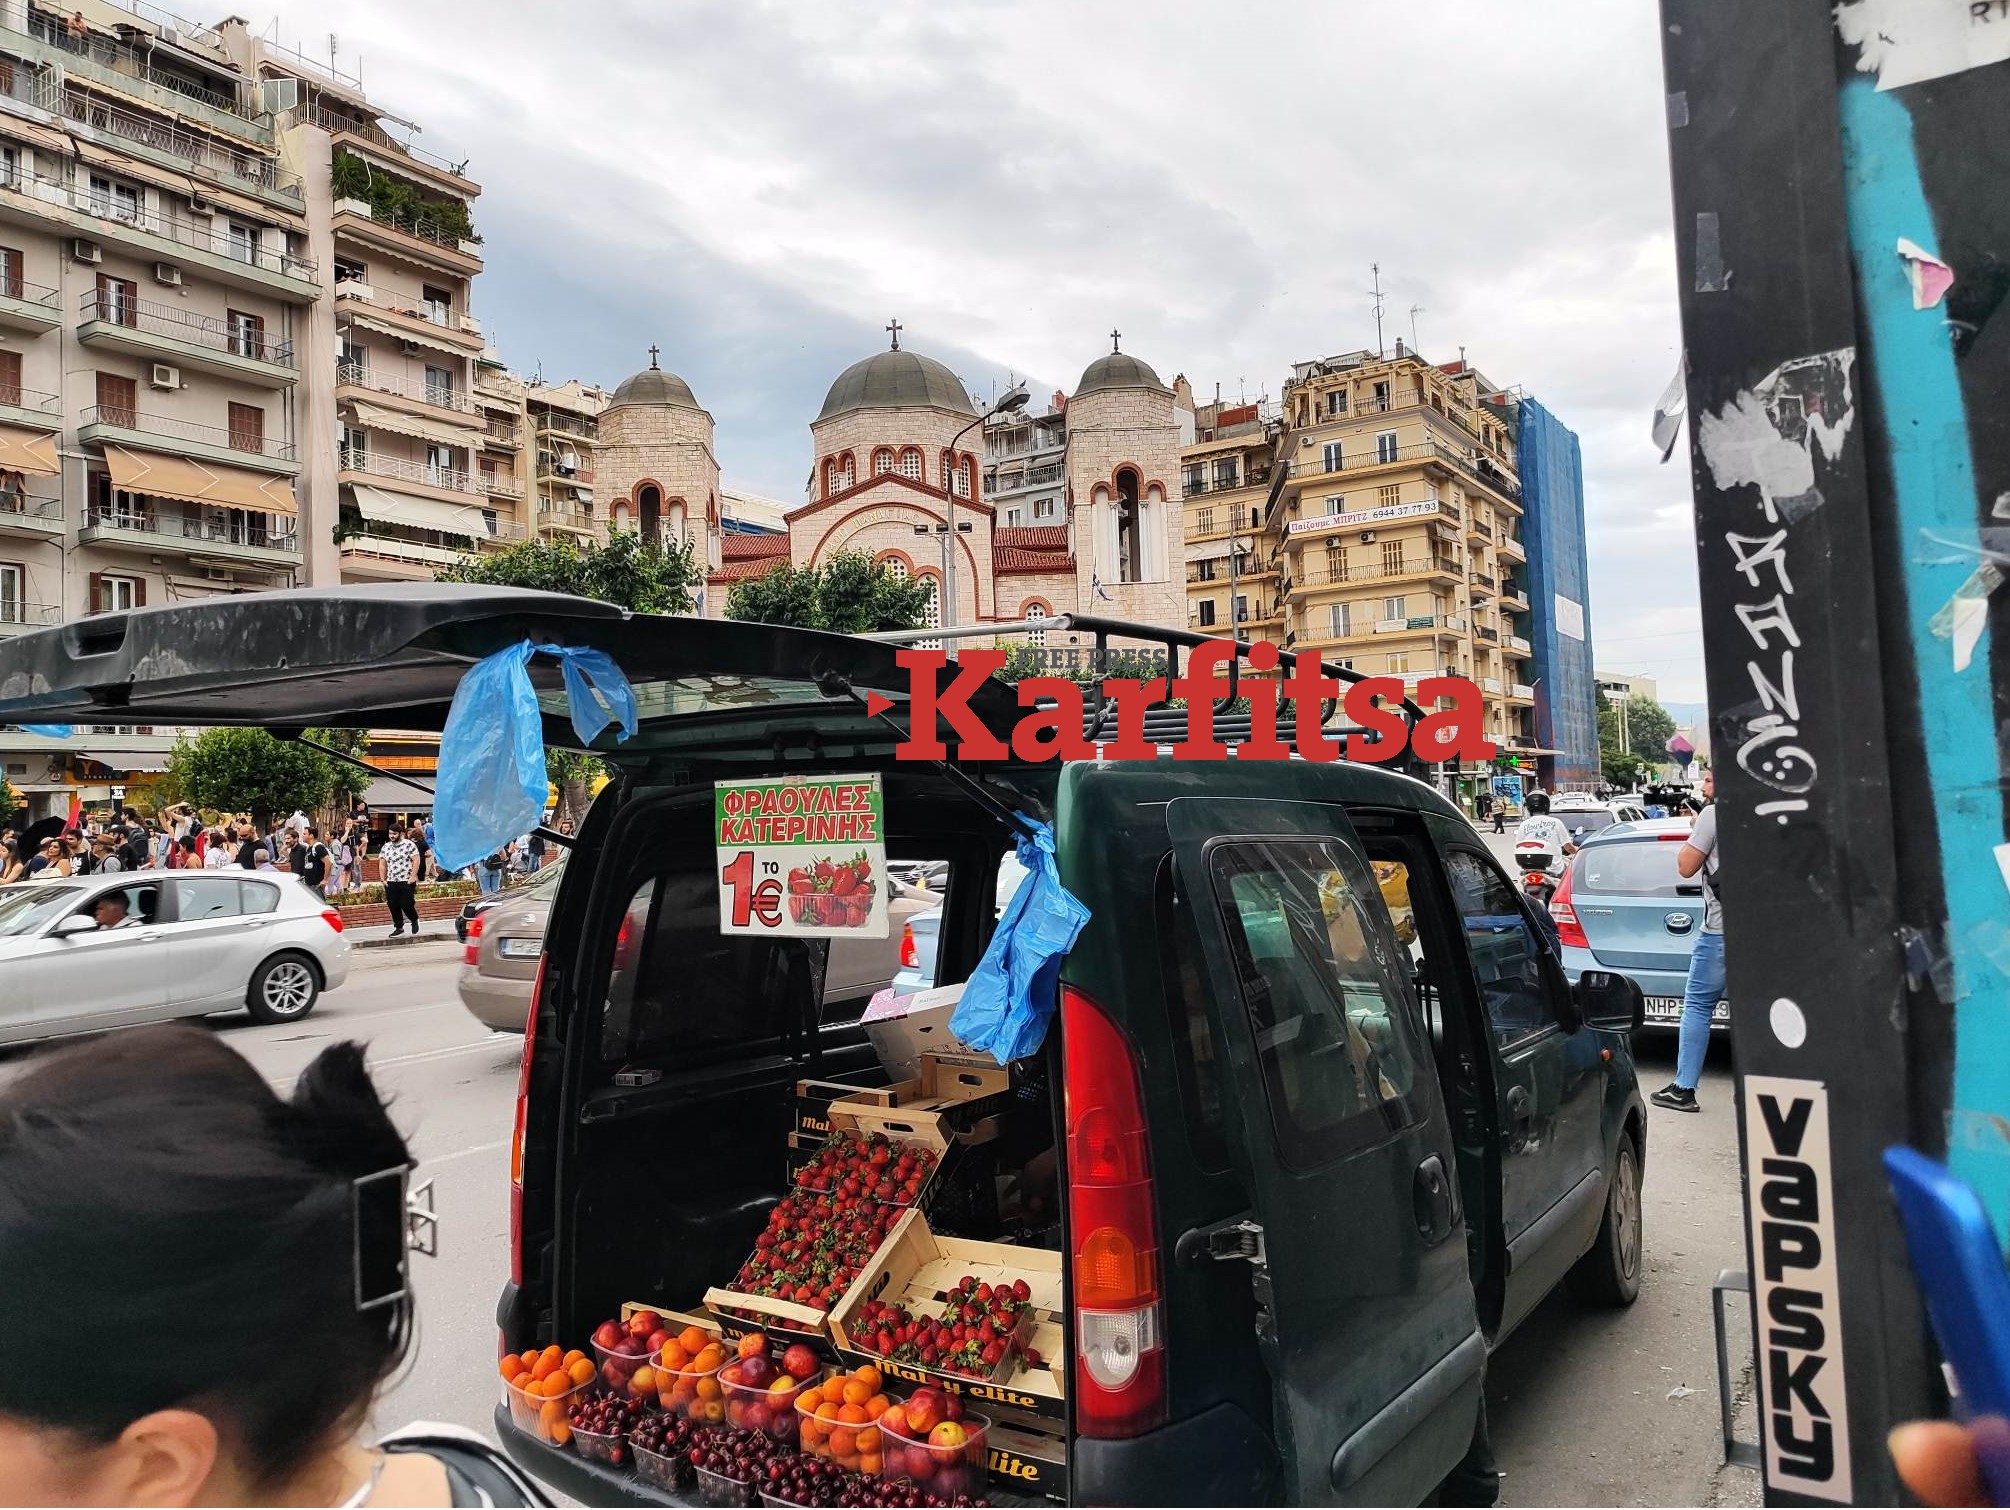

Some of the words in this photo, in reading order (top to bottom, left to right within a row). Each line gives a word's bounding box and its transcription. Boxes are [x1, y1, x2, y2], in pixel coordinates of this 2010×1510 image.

[1372, 509, 1395, 519] 6944
[1397, 507, 1409, 516] 37
[1411, 504, 1422, 514] 77
[1425, 502, 1437, 512] 93
[723, 784, 872, 817] ΦΡΑΟΥΛΕΣ
[720, 813, 877, 844] ΚΑΤΕΡΙΝΗΣ
[1645, 999, 1677, 1014] NHP
[969, 1386, 1040, 1408] elite
[988, 1451, 1041, 1481] lite
